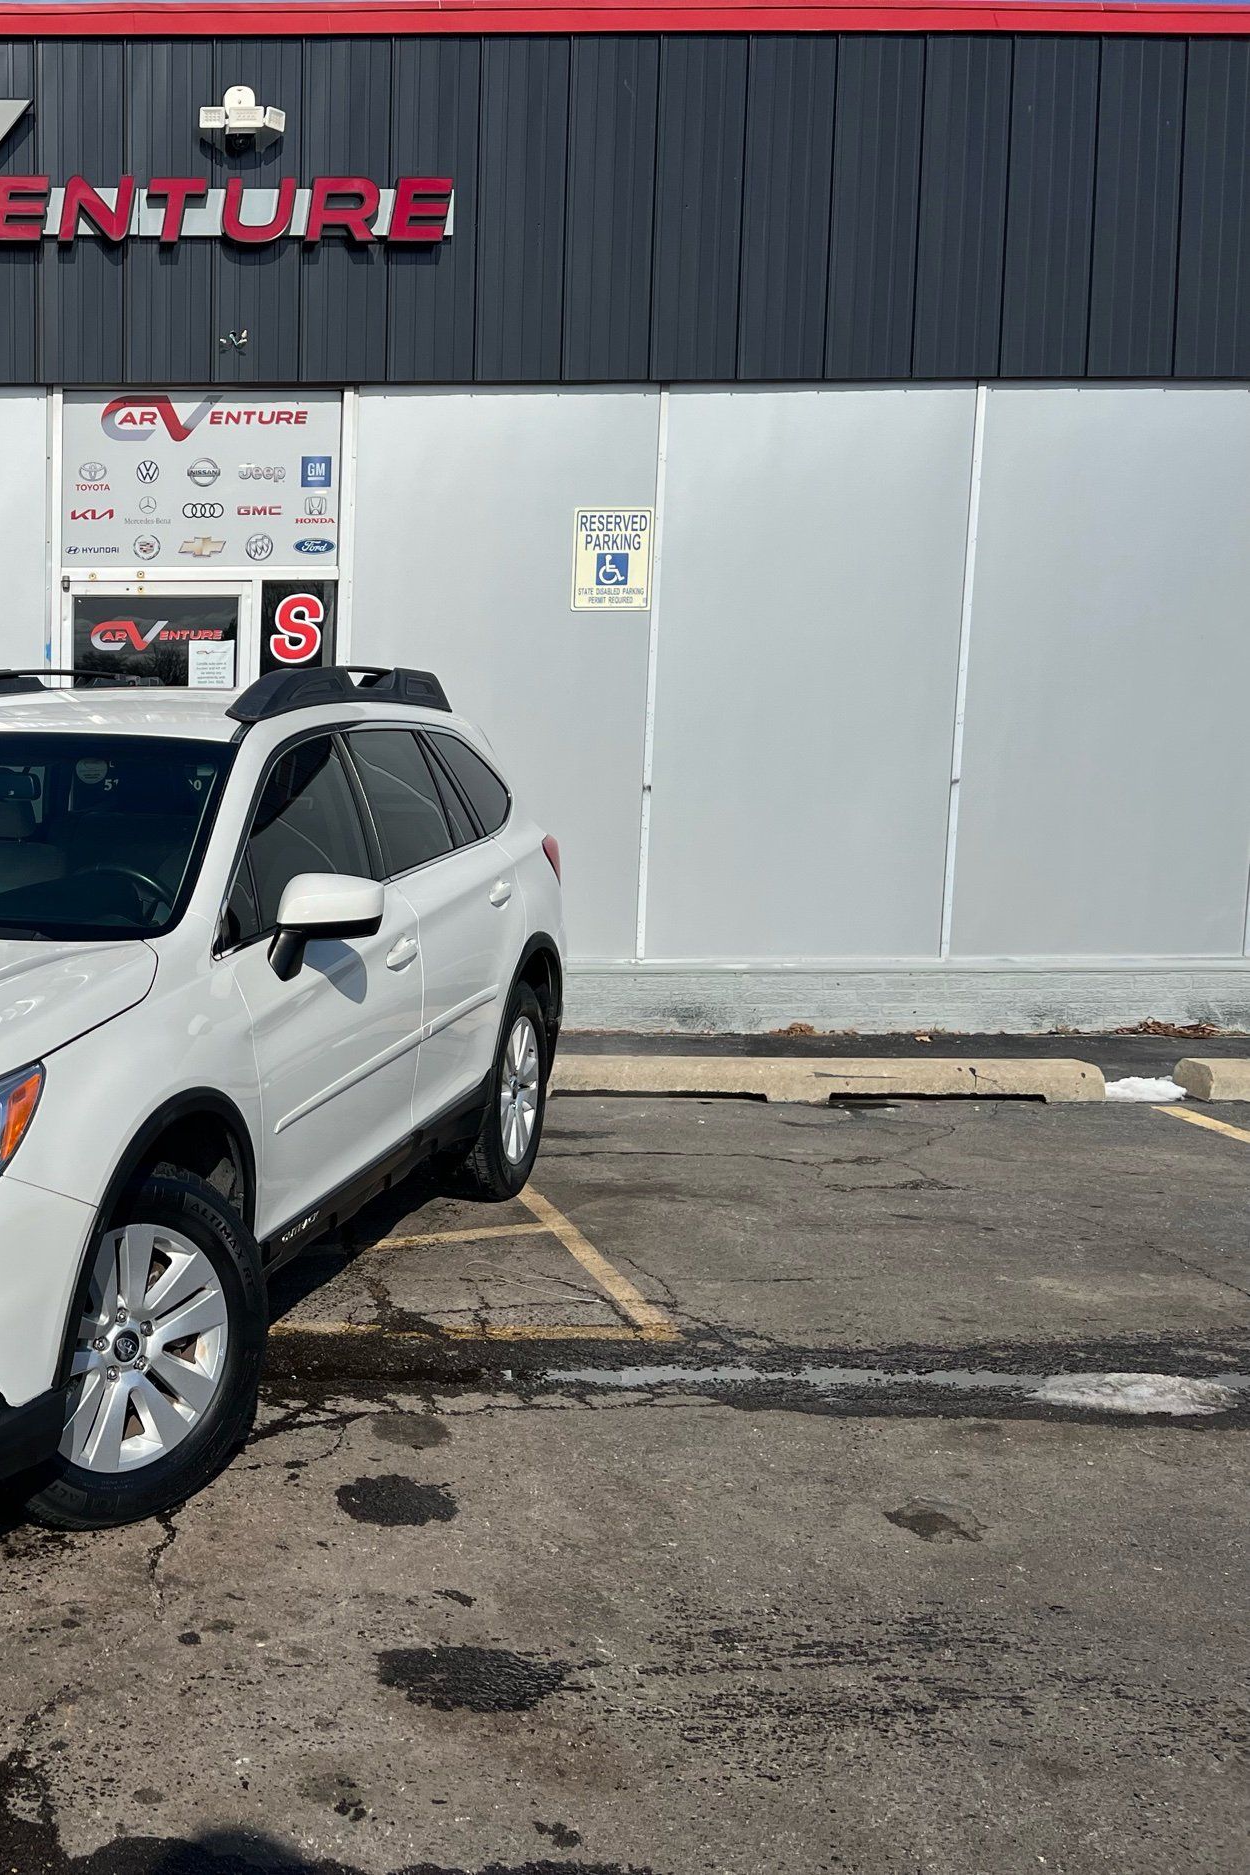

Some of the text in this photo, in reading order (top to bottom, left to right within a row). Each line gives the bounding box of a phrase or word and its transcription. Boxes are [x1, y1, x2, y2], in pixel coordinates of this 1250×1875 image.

[238, 463, 286, 483] Jeep
[307, 463, 325, 476] GM
[237, 505, 282, 516] GMC
[580, 514, 648, 532] RESERVED
[301, 540, 328, 552] Ford
[585, 533, 641, 551] PARKING
[578, 588, 645, 596] STATE DISABLED PARKING
[270, 593, 324, 663] S
[190, 1203, 245, 1260] ALTIMAX
